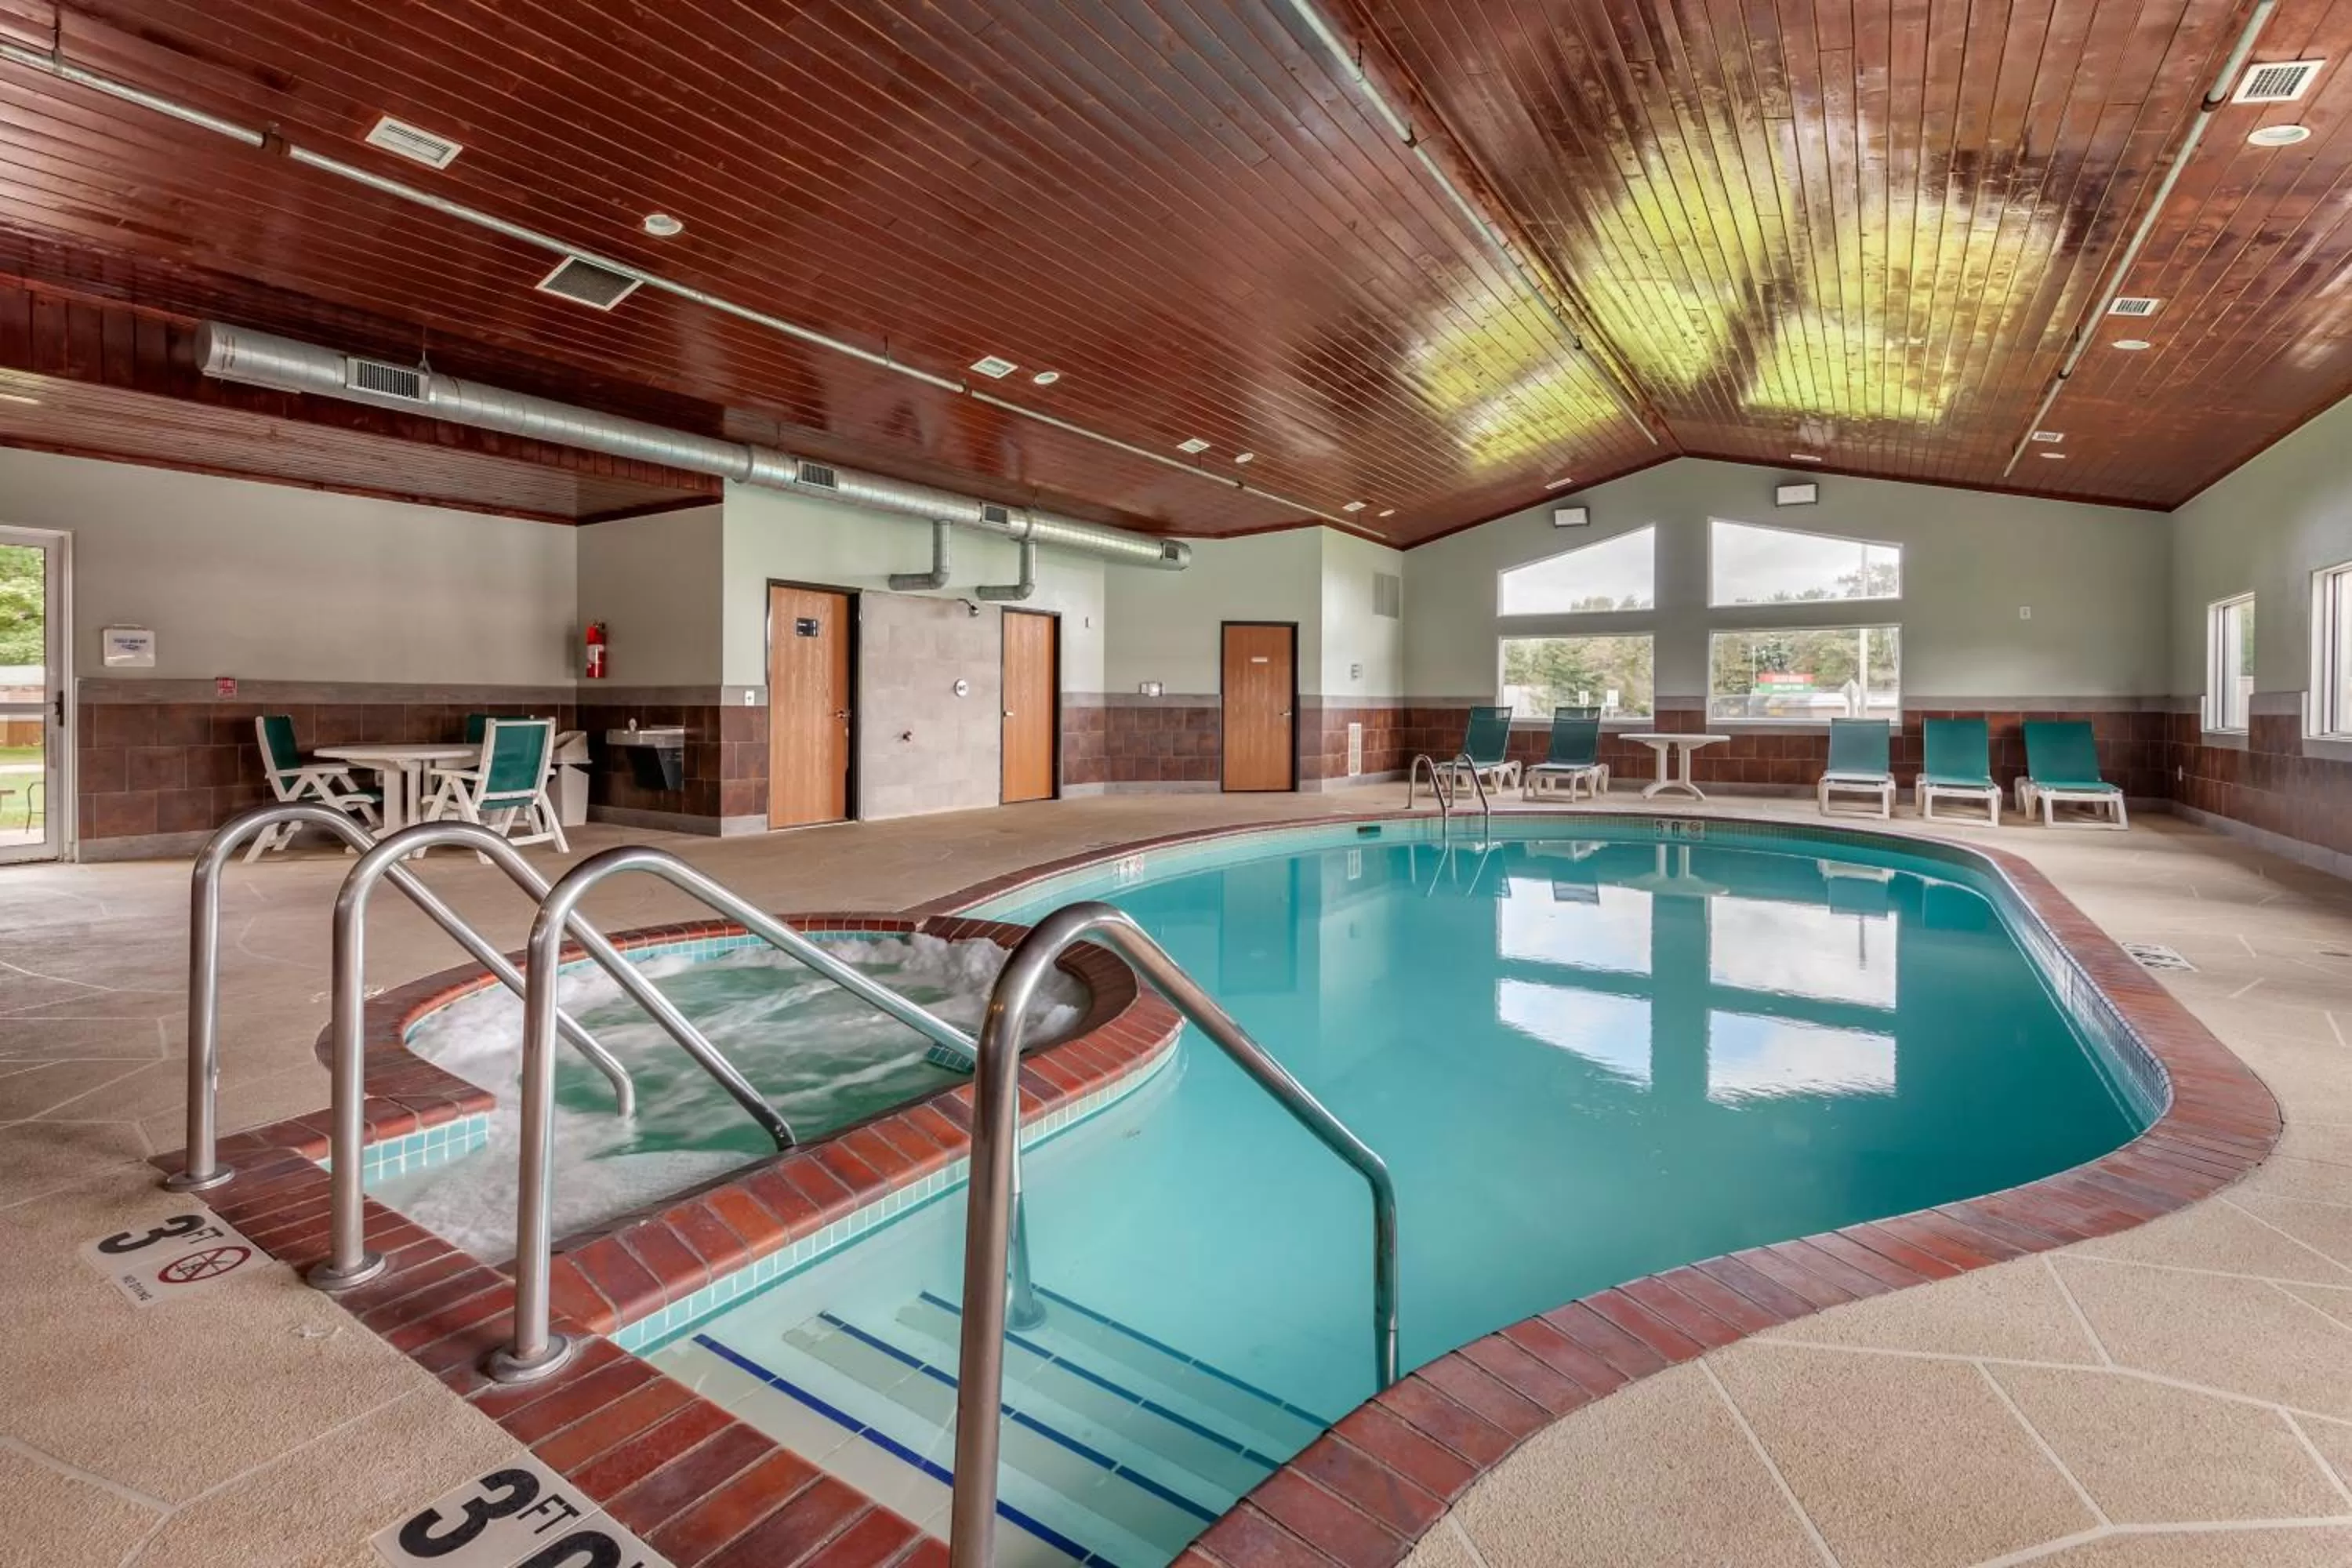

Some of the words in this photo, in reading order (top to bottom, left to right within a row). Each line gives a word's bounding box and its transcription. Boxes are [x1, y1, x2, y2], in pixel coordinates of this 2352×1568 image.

[97, 1214, 206, 1254] 3
[180, 1226, 225, 1245] FT
[398, 1468, 540, 1559] 3
[517, 1494, 581, 1534] FT
